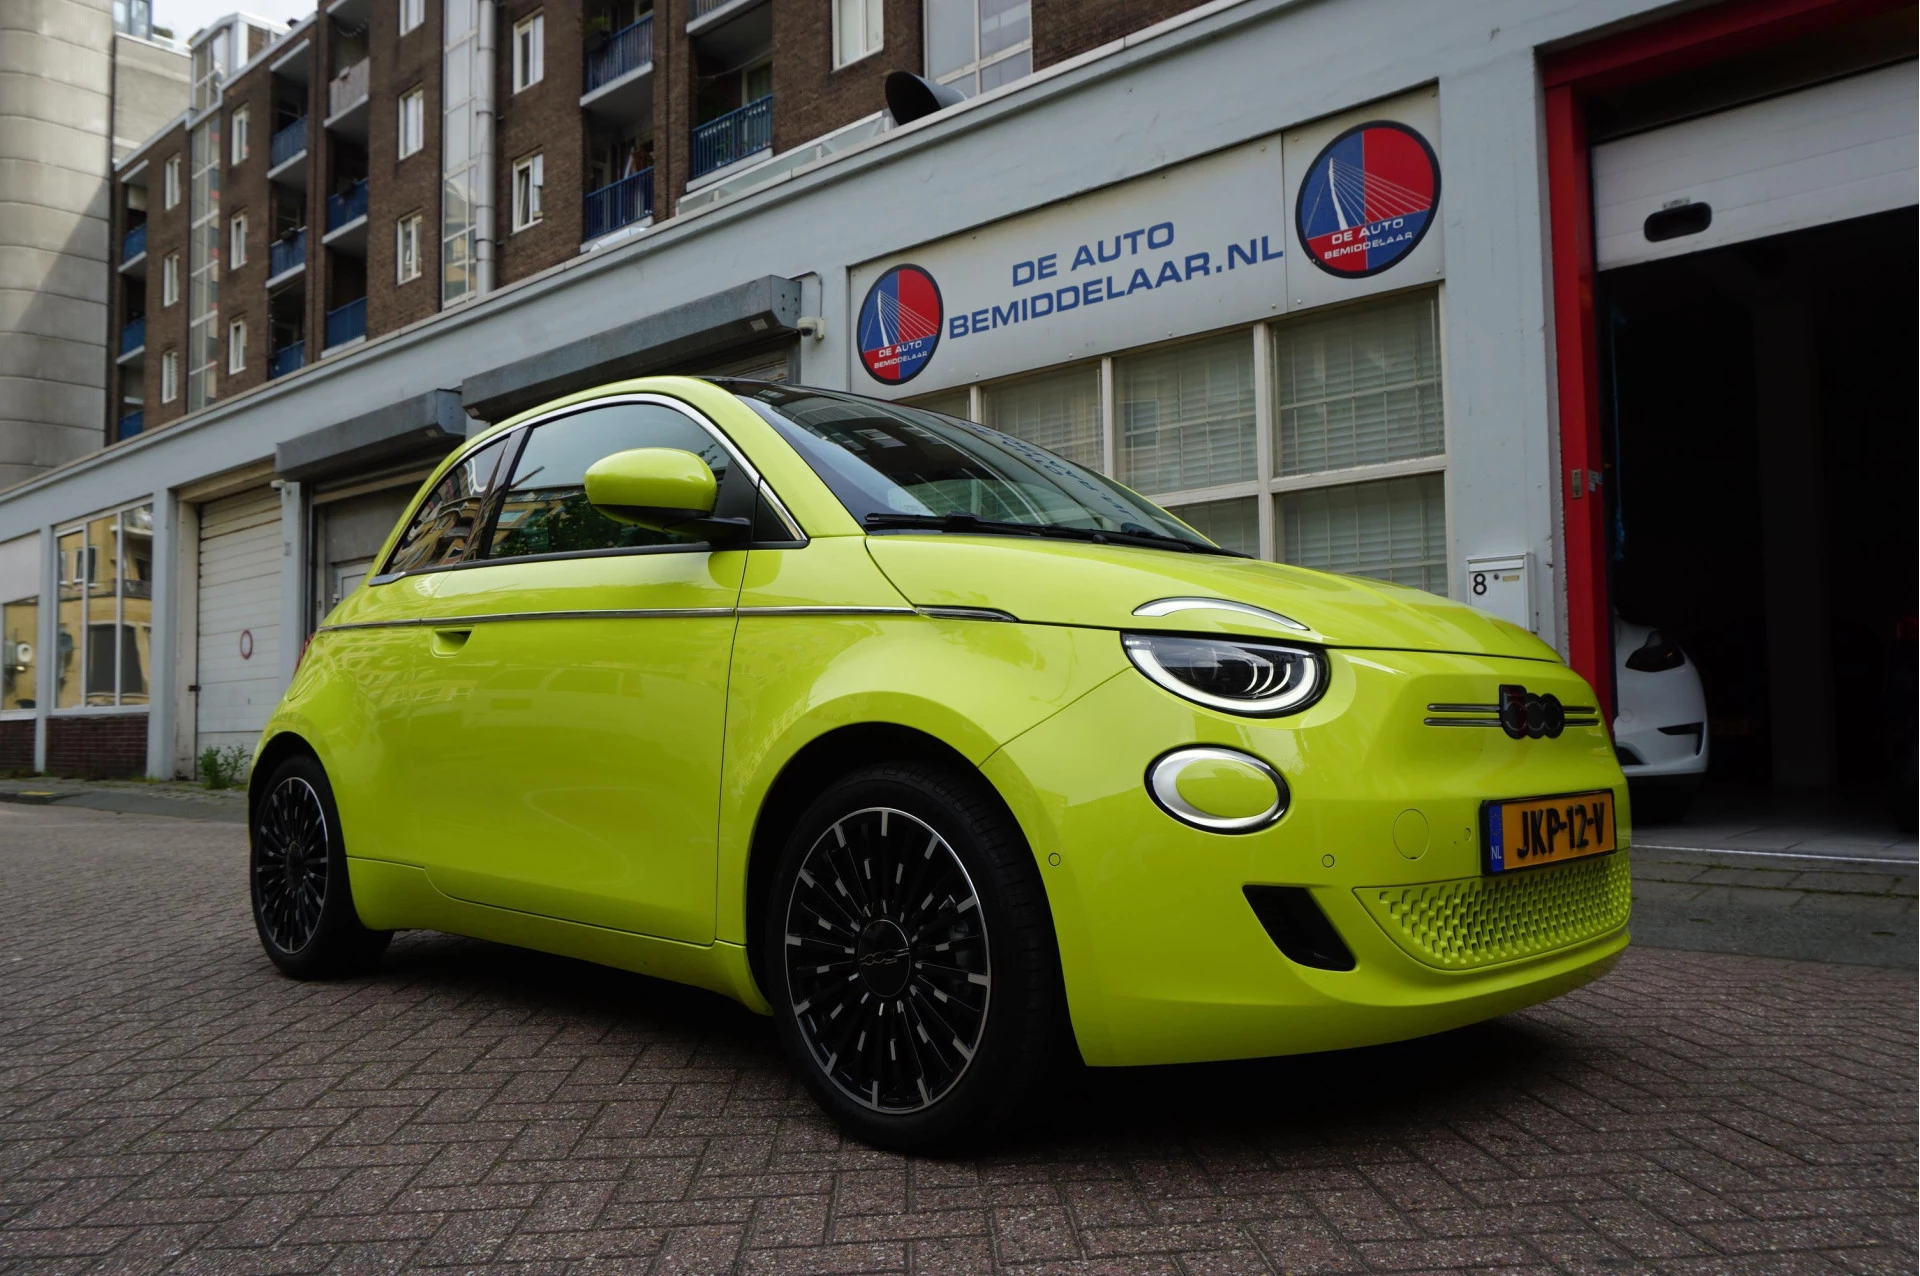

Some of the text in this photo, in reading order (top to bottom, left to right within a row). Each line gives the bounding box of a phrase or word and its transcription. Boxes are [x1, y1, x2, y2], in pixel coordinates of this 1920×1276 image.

[1332, 218, 1404, 245] DE AUTO
[1012, 221, 1175, 287] DE AUTO
[1324, 231, 1413, 260] BEMIDDELAAR
[949, 236, 1284, 340] BEMIDDELAAR.NL
[874, 352, 928, 369] BEMIDDELAAR
[879, 341, 922, 358] DE AUTO
[1473, 573, 1487, 596] 8
[1517, 802, 1605, 860] JKP-12-V
[1491, 846, 1502, 861] NL
